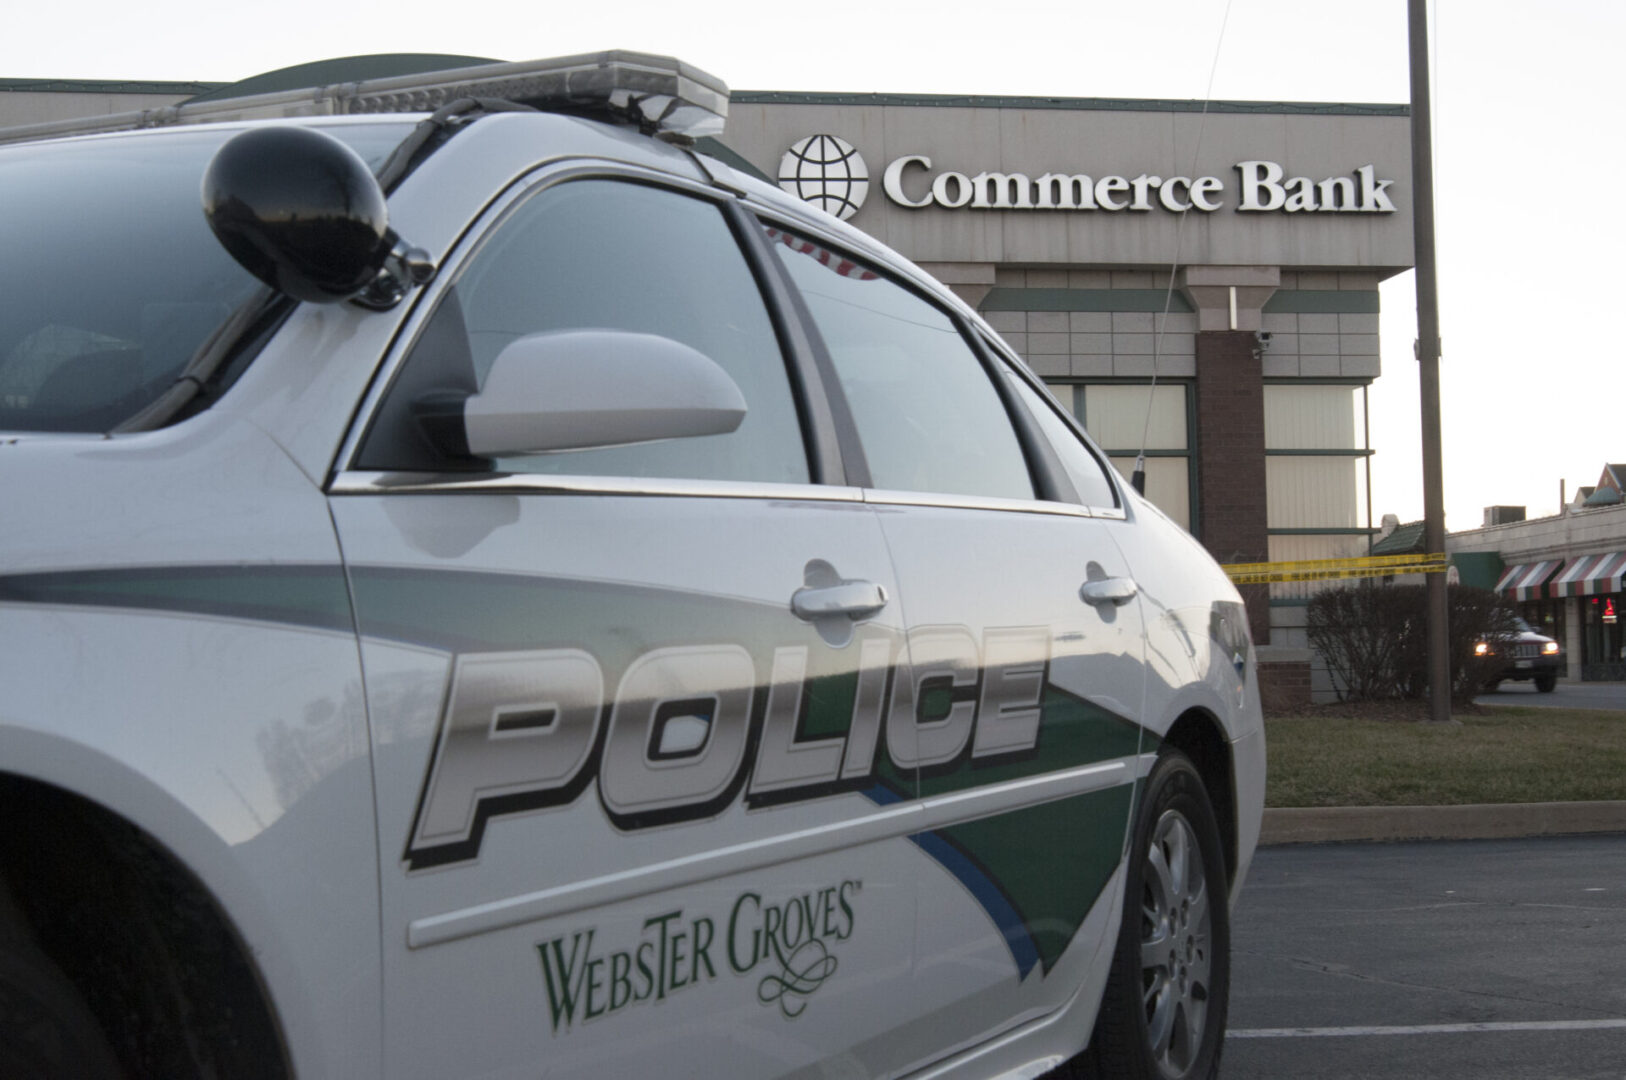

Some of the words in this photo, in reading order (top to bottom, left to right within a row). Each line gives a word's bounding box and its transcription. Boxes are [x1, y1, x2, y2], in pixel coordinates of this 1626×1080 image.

[882, 155, 1225, 214] Commerce
[1236, 160, 1397, 215] Bank
[402, 624, 1050, 874] POLICE
[536, 910, 717, 1034] WEBSTER
[727, 879, 856, 1018] GROVES
